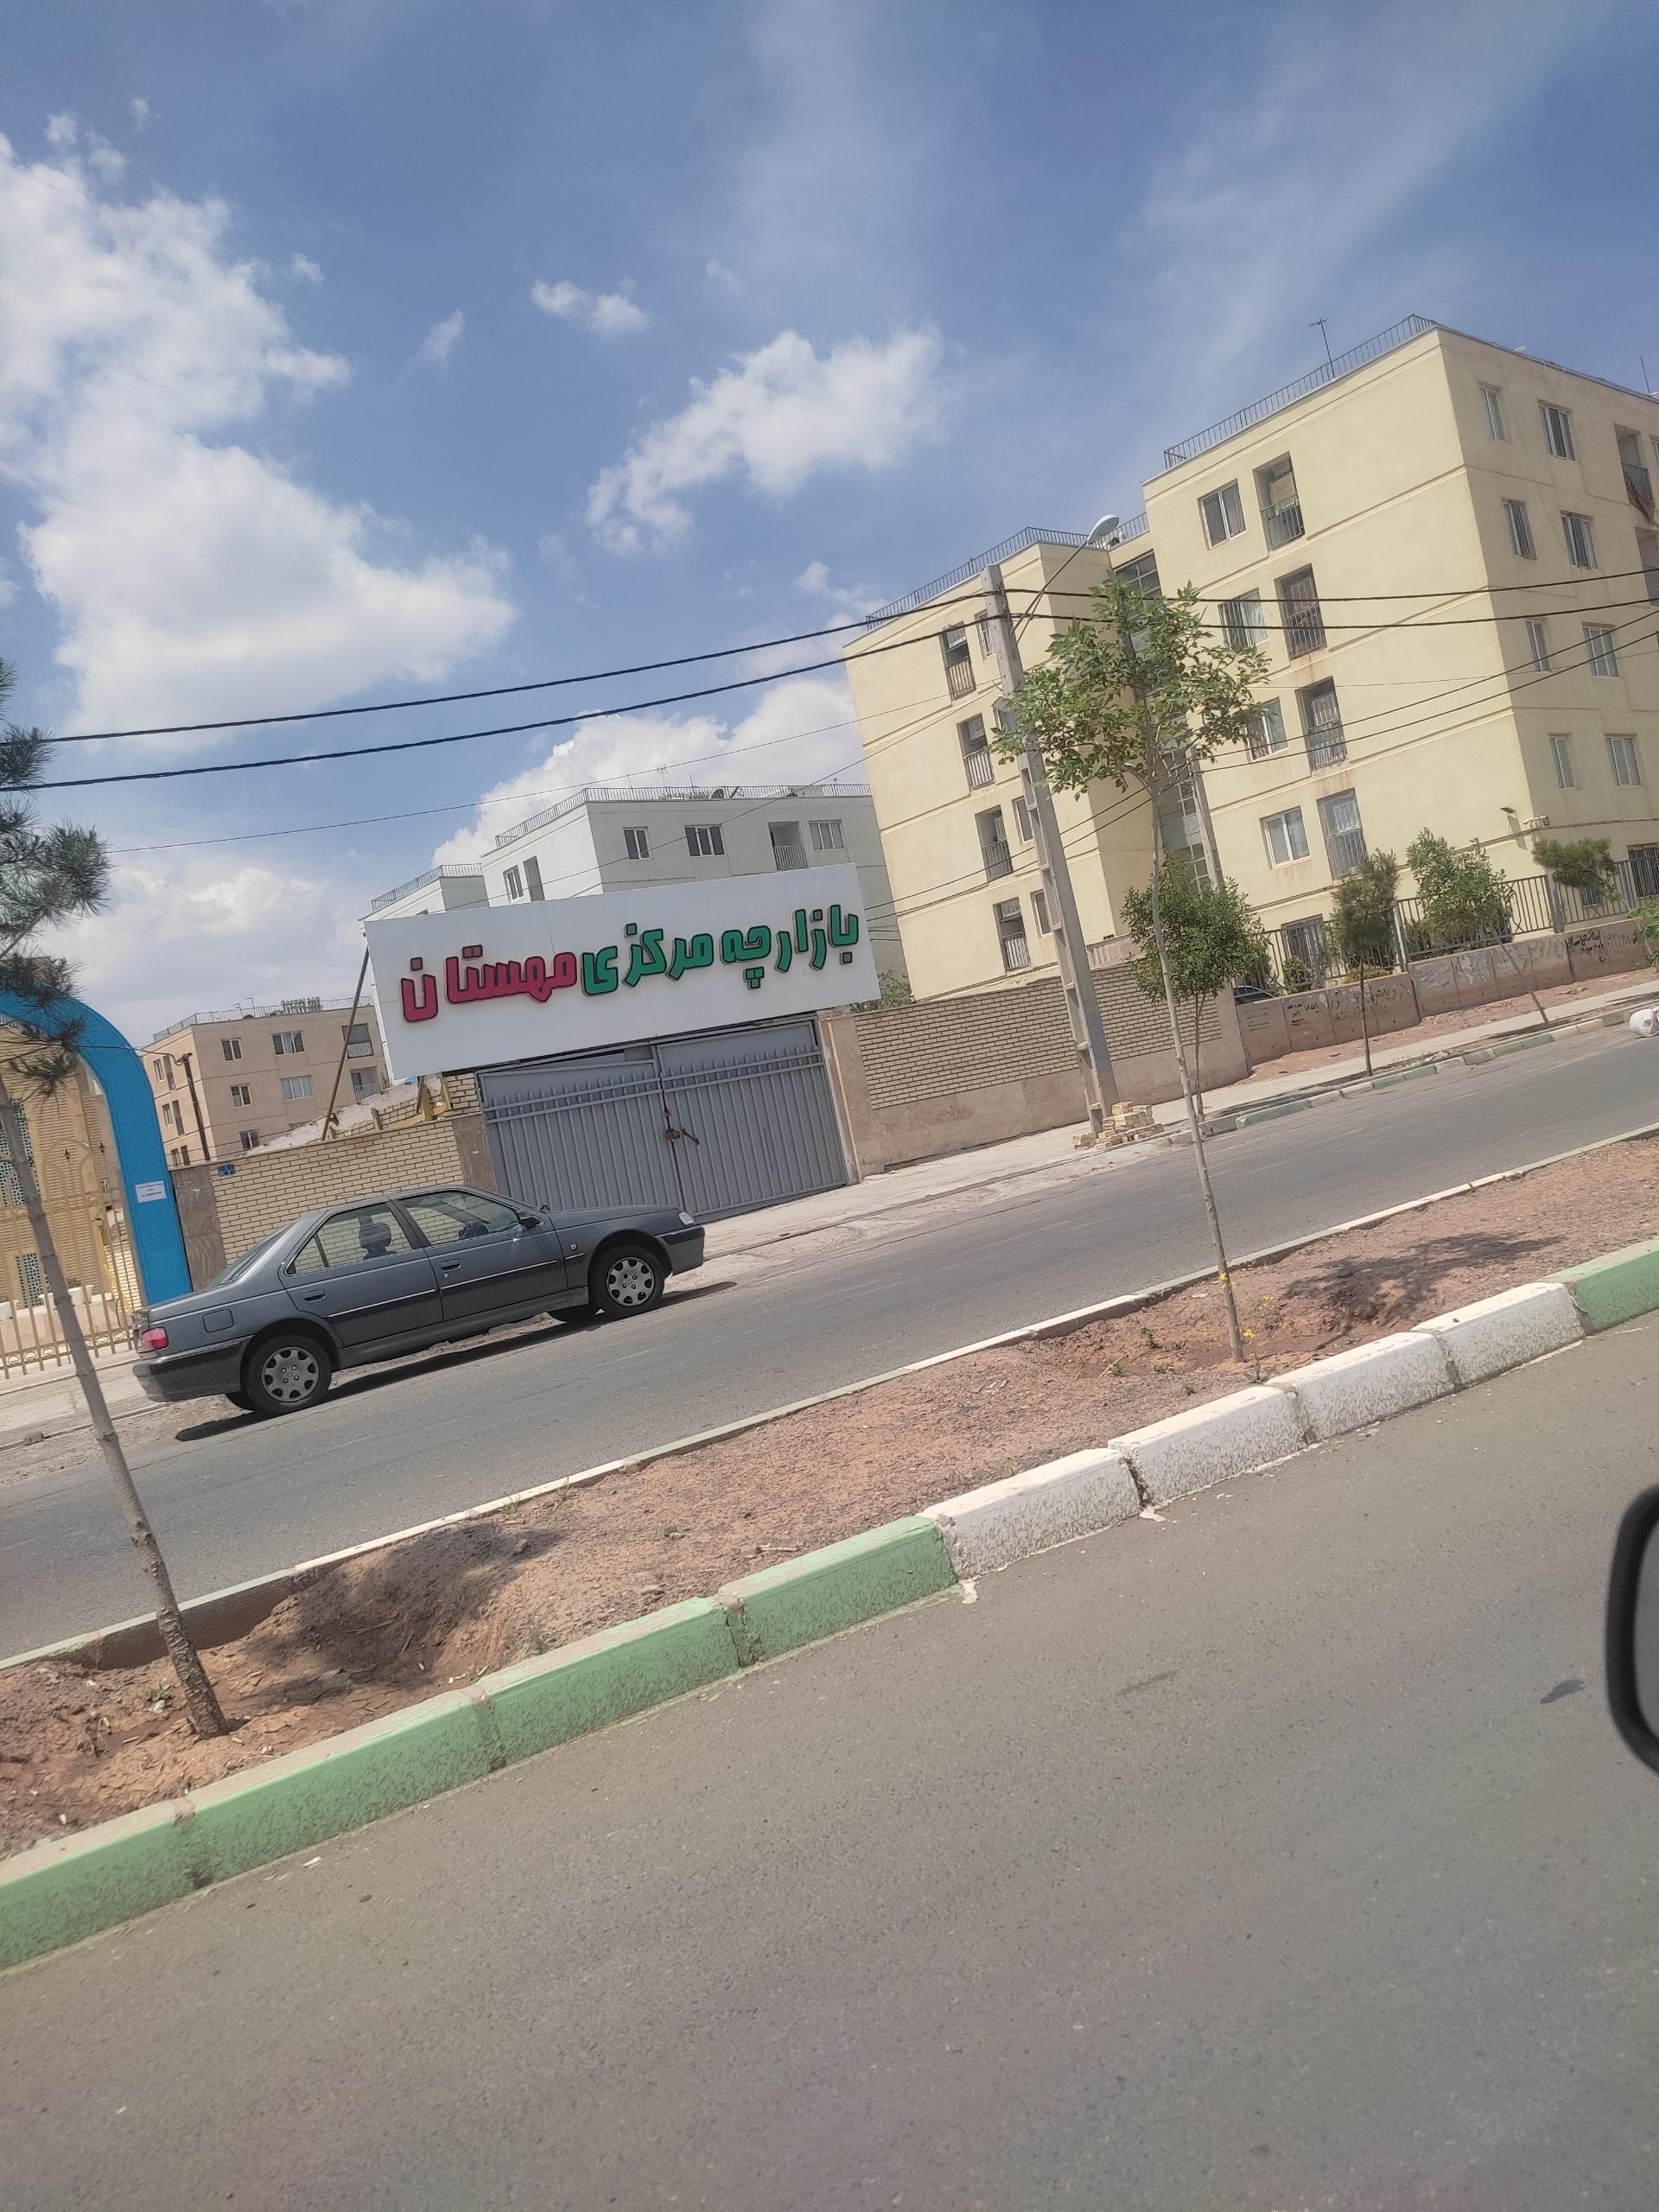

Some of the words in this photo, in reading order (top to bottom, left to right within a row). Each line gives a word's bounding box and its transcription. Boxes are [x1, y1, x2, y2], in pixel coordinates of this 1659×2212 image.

[400, 944, 578, 1023] مهستان
[581, 922, 715, 996] مرکزی
[721, 904, 859, 990] بازارچه
